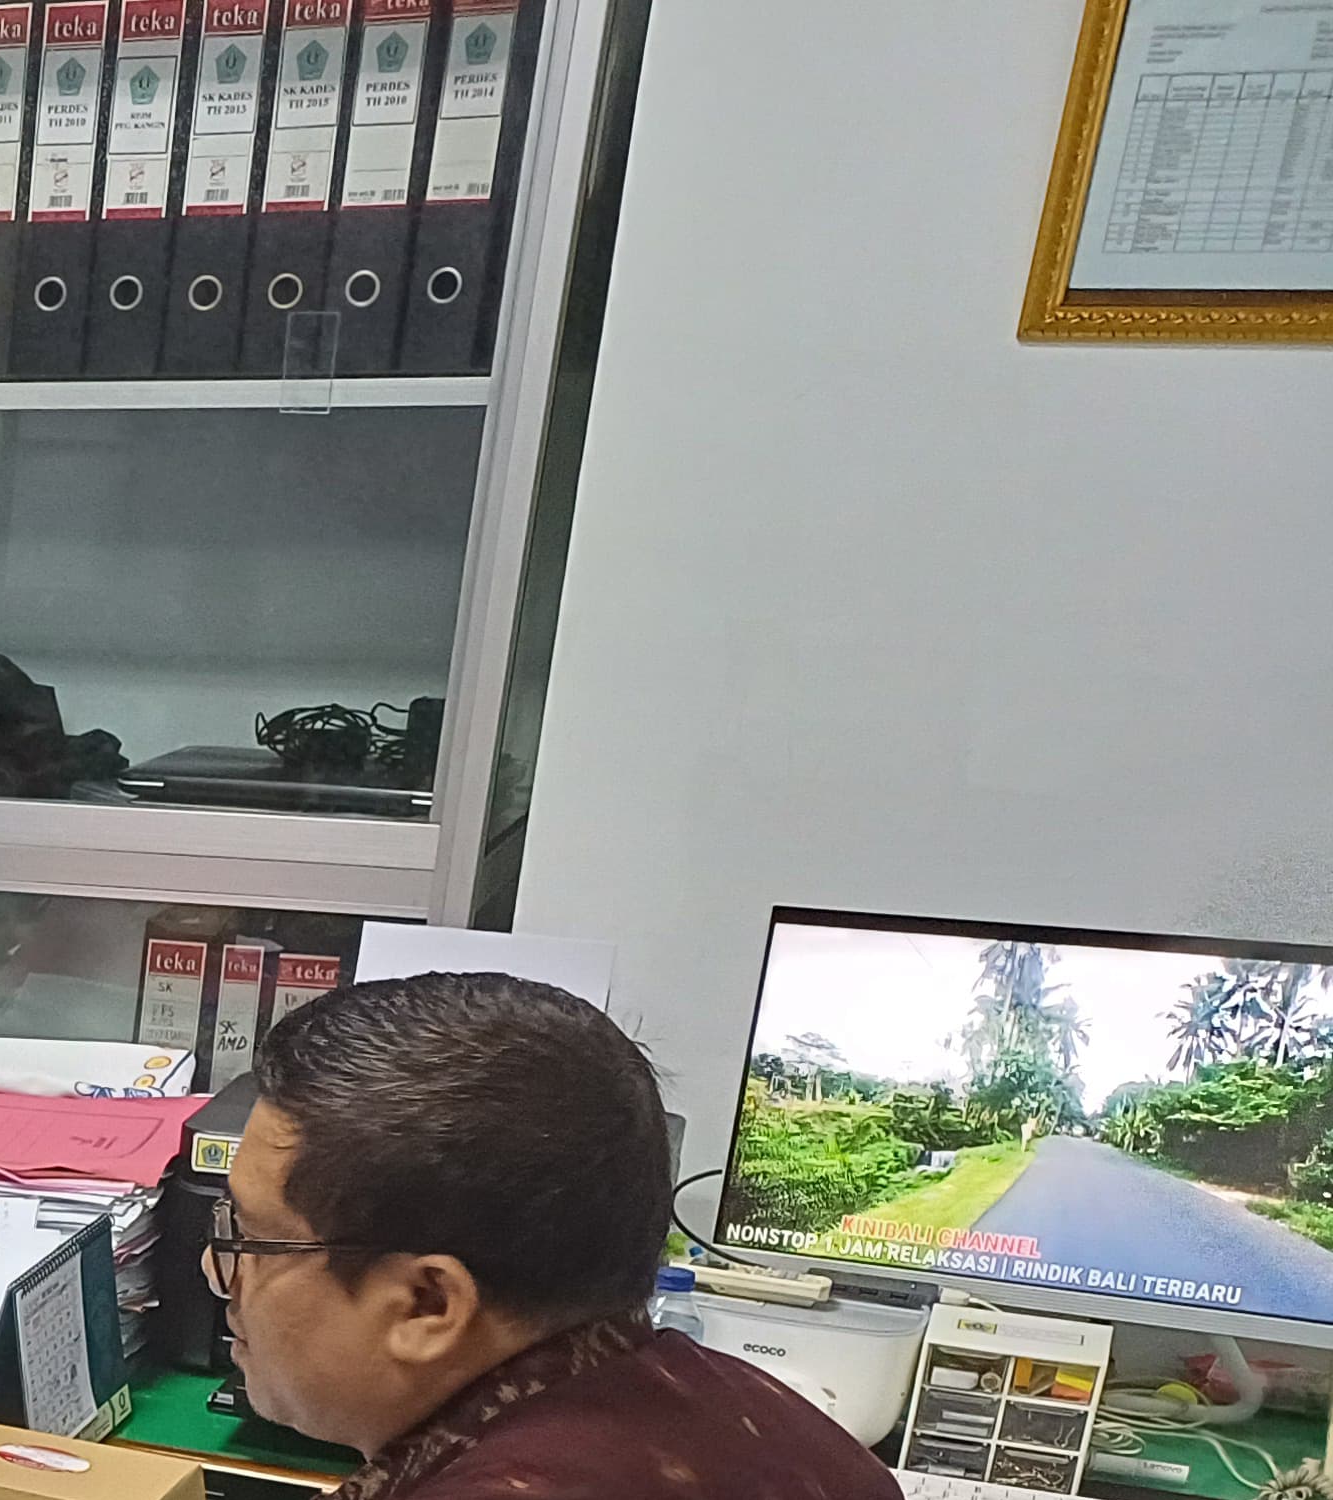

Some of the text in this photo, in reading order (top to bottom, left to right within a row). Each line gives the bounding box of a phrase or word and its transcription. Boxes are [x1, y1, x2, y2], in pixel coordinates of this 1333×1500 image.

[213, 4, 258, 27] teka
[294, 0, 340, 20] teka
[54, 14, 97, 38] teka
[131, 9, 175, 32] teka
[365, 81, 411, 93] PERDES
[47, 104, 89, 115] PERDES
[155, 952, 197, 971] teka
[295, 963, 337, 981] teka
[842, 1215, 1041, 1259] KINIBALI CHANNEL
[726, 1222, 817, 1250] NONSTOP
[838, 1239, 882, 1259] JAM
[886, 1243, 996, 1274] RELAKSASI
[1012, 1260, 1084, 1286] RINDIK
[1087, 1269, 1136, 1292] BALI
[1143, 1276, 1242, 1305] TERBARU
[743, 1343, 786, 1357] ecoco
